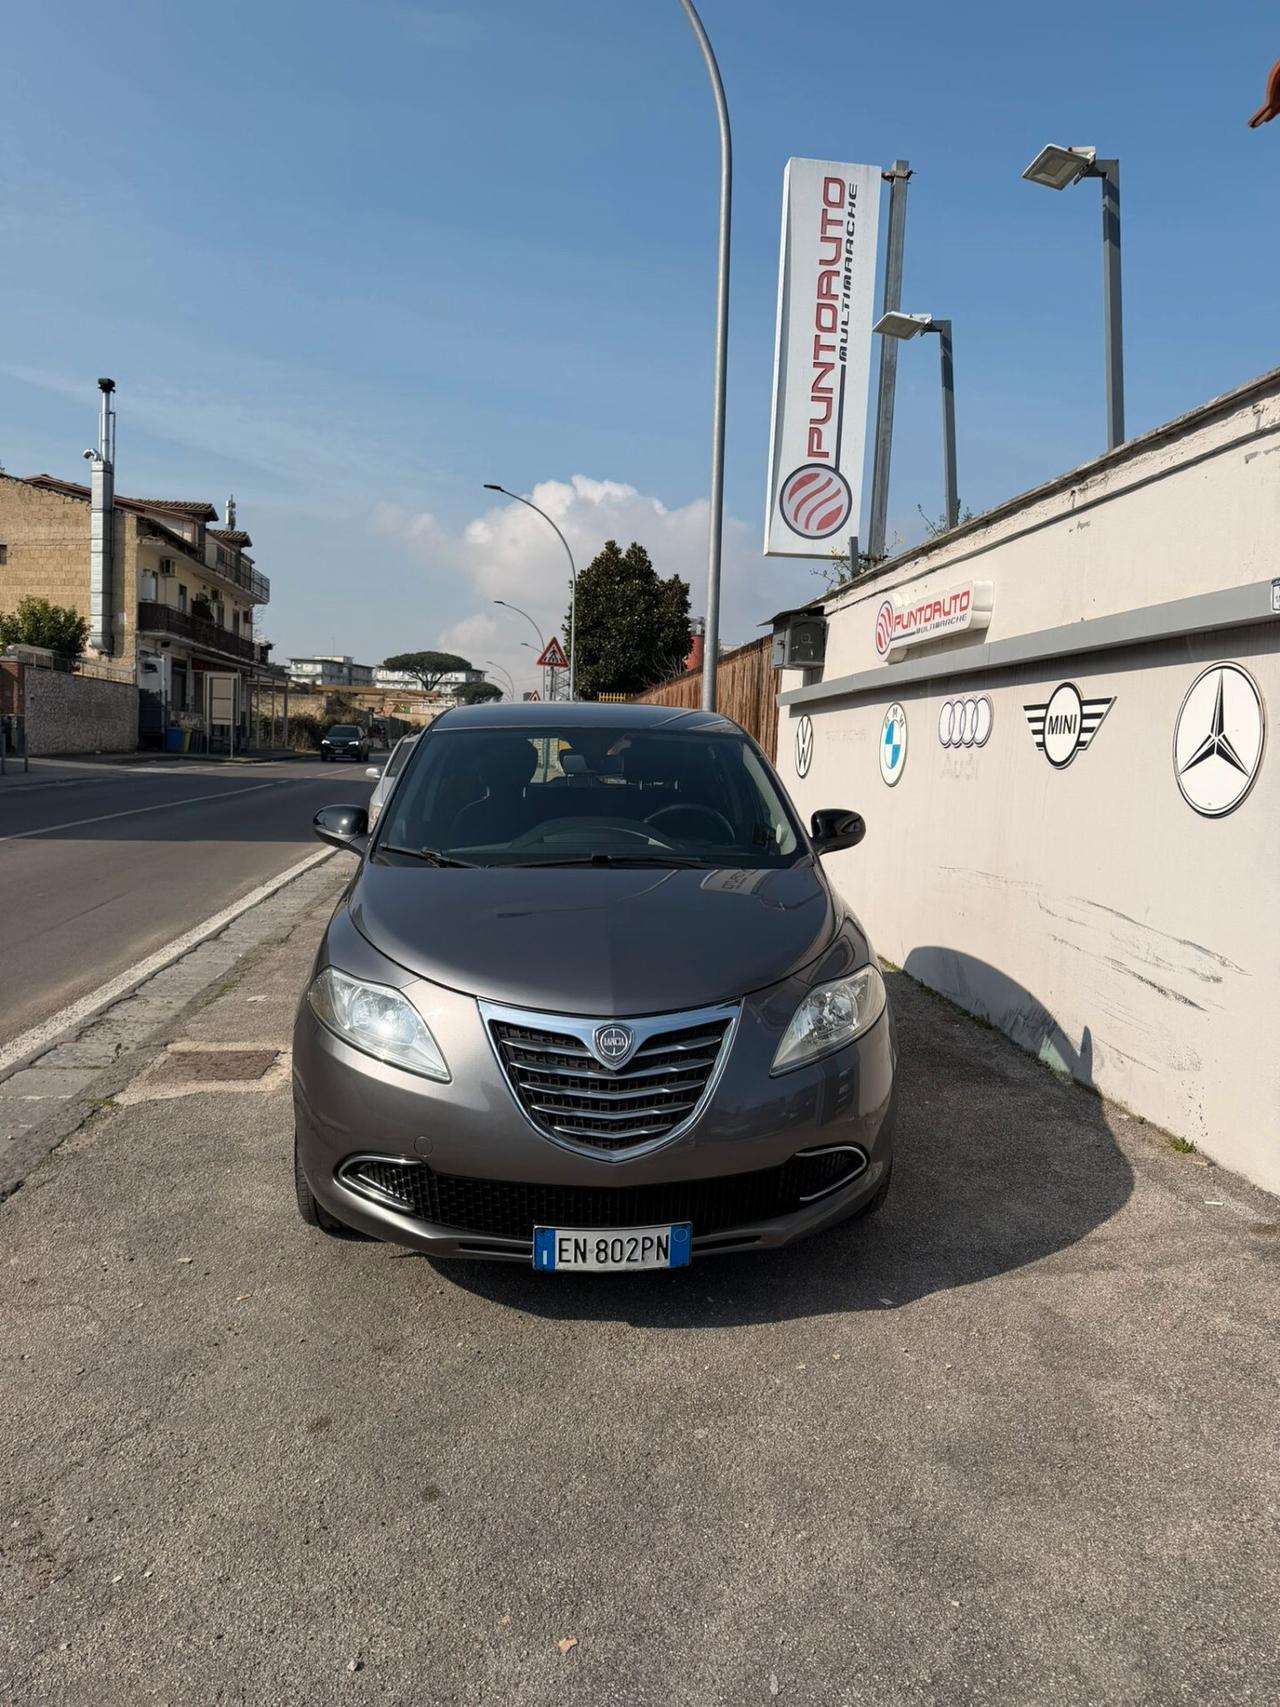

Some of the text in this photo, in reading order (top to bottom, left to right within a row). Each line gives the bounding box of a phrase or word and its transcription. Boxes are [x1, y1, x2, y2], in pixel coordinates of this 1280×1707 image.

[838, 182, 858, 362] MULTIMARCHE
[807, 176, 846, 458] PUNTOAUTO
[894, 590, 970, 632] PUNTOAUTO
[1047, 714, 1077, 735] MINI
[558, 1237, 587, 1264] EN
[595, 1234, 669, 1264] 802PN
